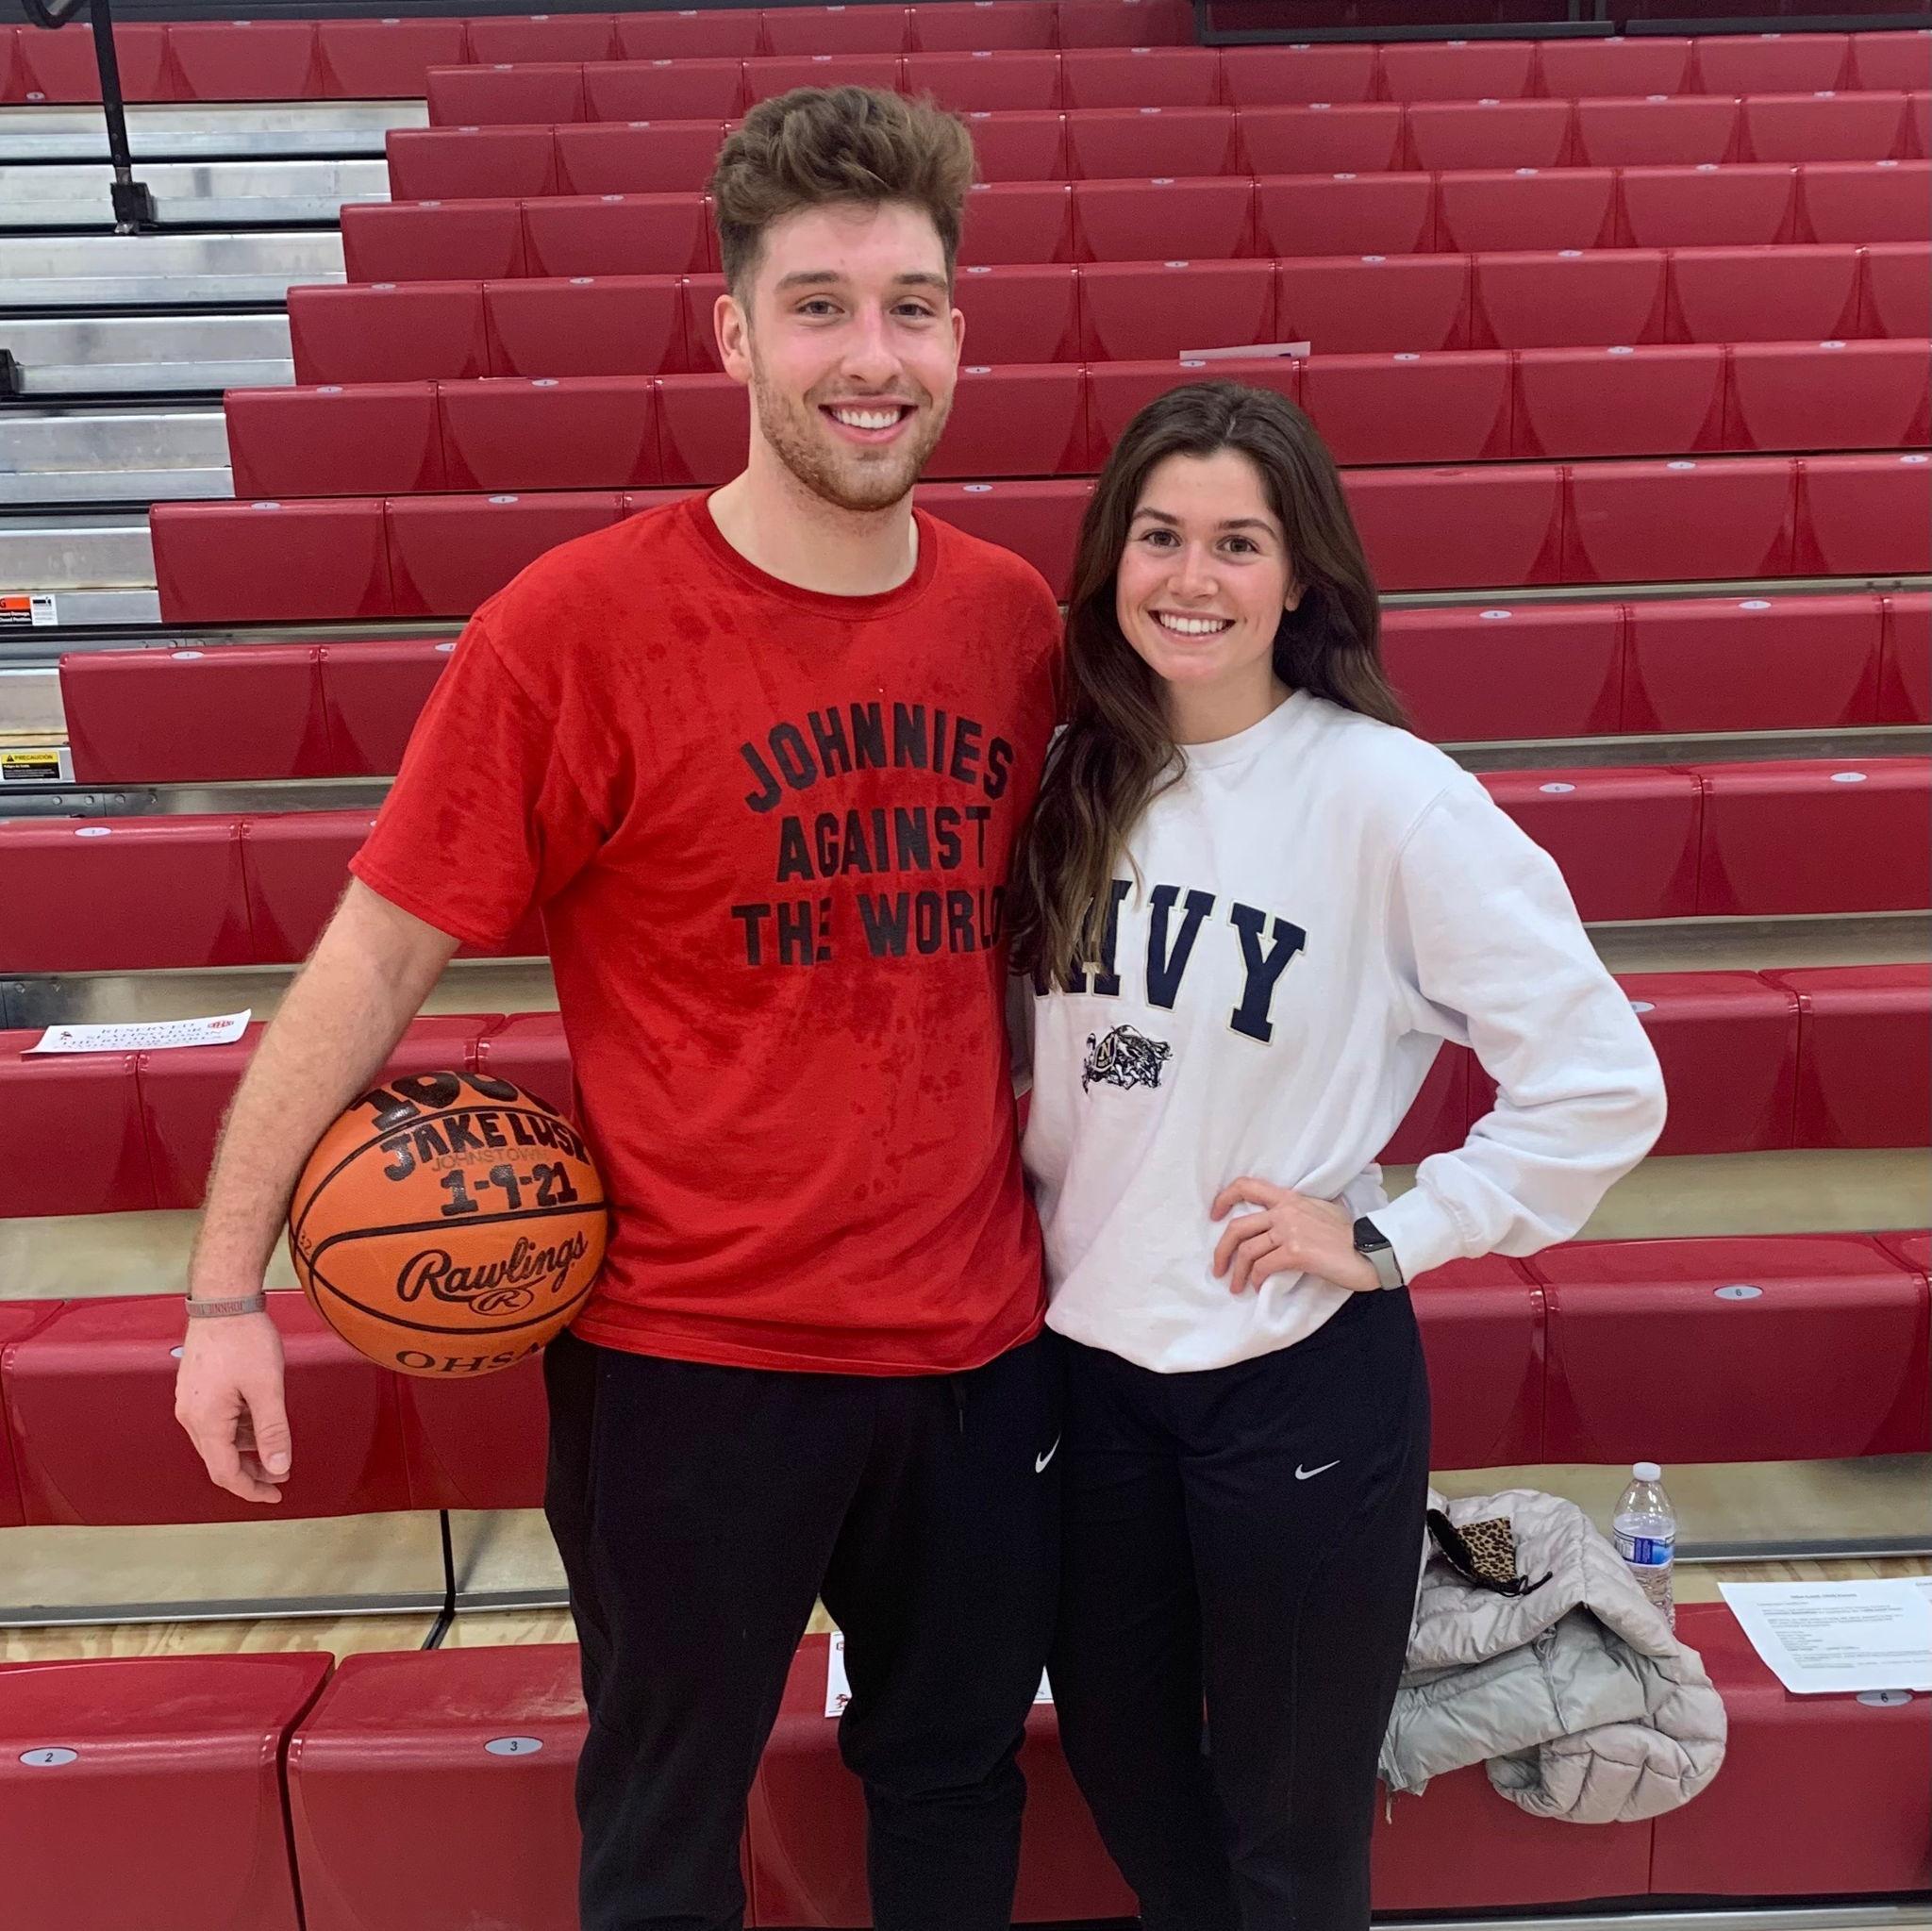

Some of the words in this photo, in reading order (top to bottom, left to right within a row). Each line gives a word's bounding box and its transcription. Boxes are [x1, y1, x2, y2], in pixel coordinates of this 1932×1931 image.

[740, 701, 1014, 814] JOHNNIES
[775, 806, 991, 883] AGAINST
[380, 1112, 508, 1181] JAKE
[441, 1161, 578, 1217] 1-9-21
[396, 1230, 589, 1303] Rawlings
[1880, 1692, 1889, 1703] 6
[44, 1752, 54, 1763] 2
[509, 1740, 518, 1752] 3
